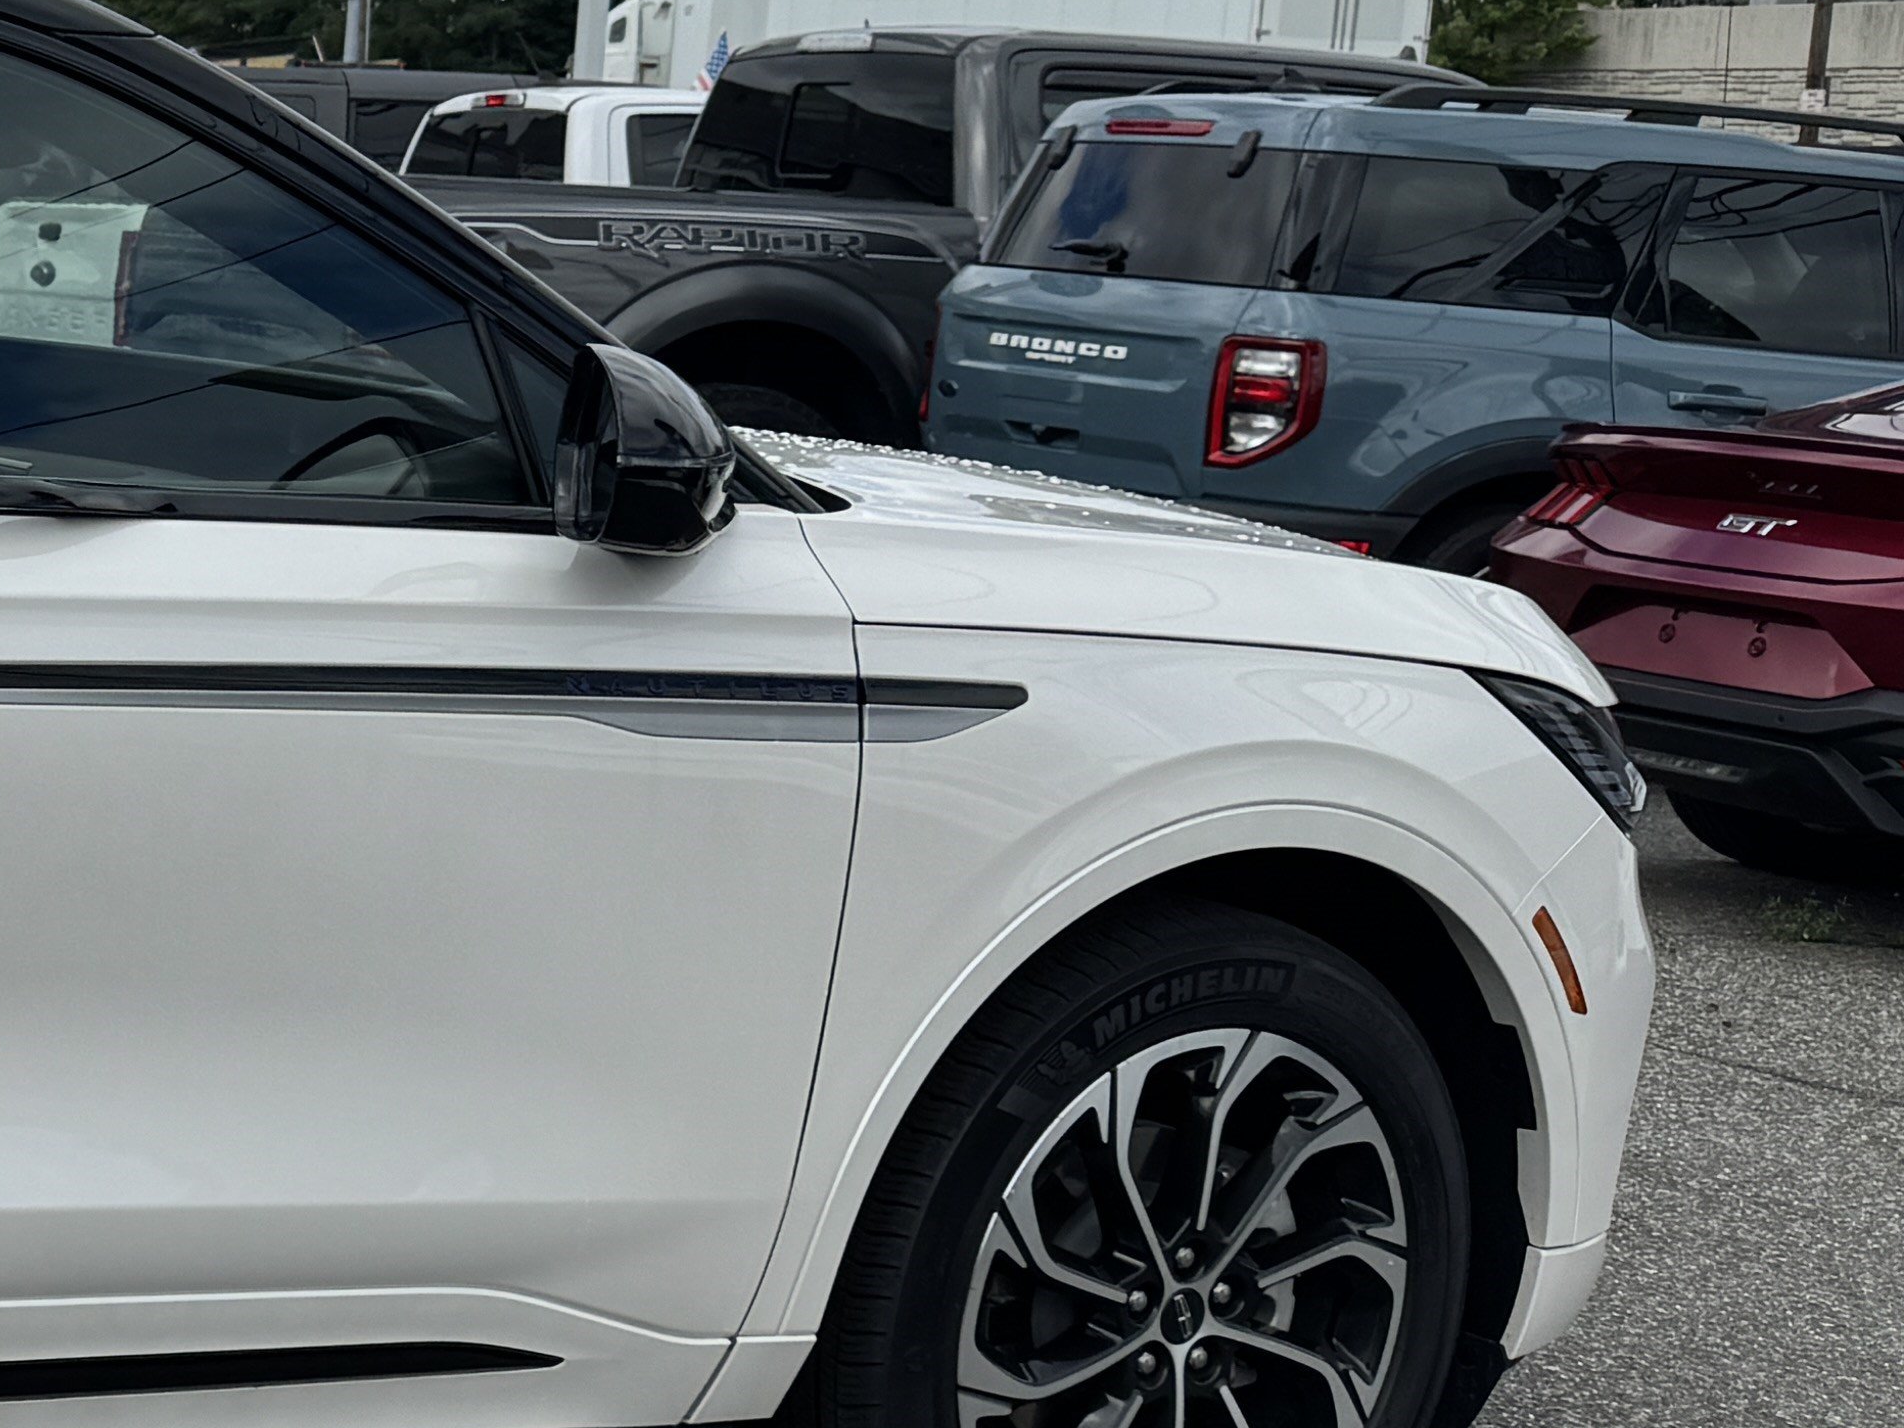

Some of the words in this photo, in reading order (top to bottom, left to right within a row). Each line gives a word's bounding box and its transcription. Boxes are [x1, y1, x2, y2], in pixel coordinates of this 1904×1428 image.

[599, 219, 868, 266] RAPTOR
[989, 332, 1128, 360] BRONCO
[1716, 512, 1798, 536] GT
[565, 676, 852, 701] NAUTILUS
[1093, 965, 1288, 1050] MICHELIN
